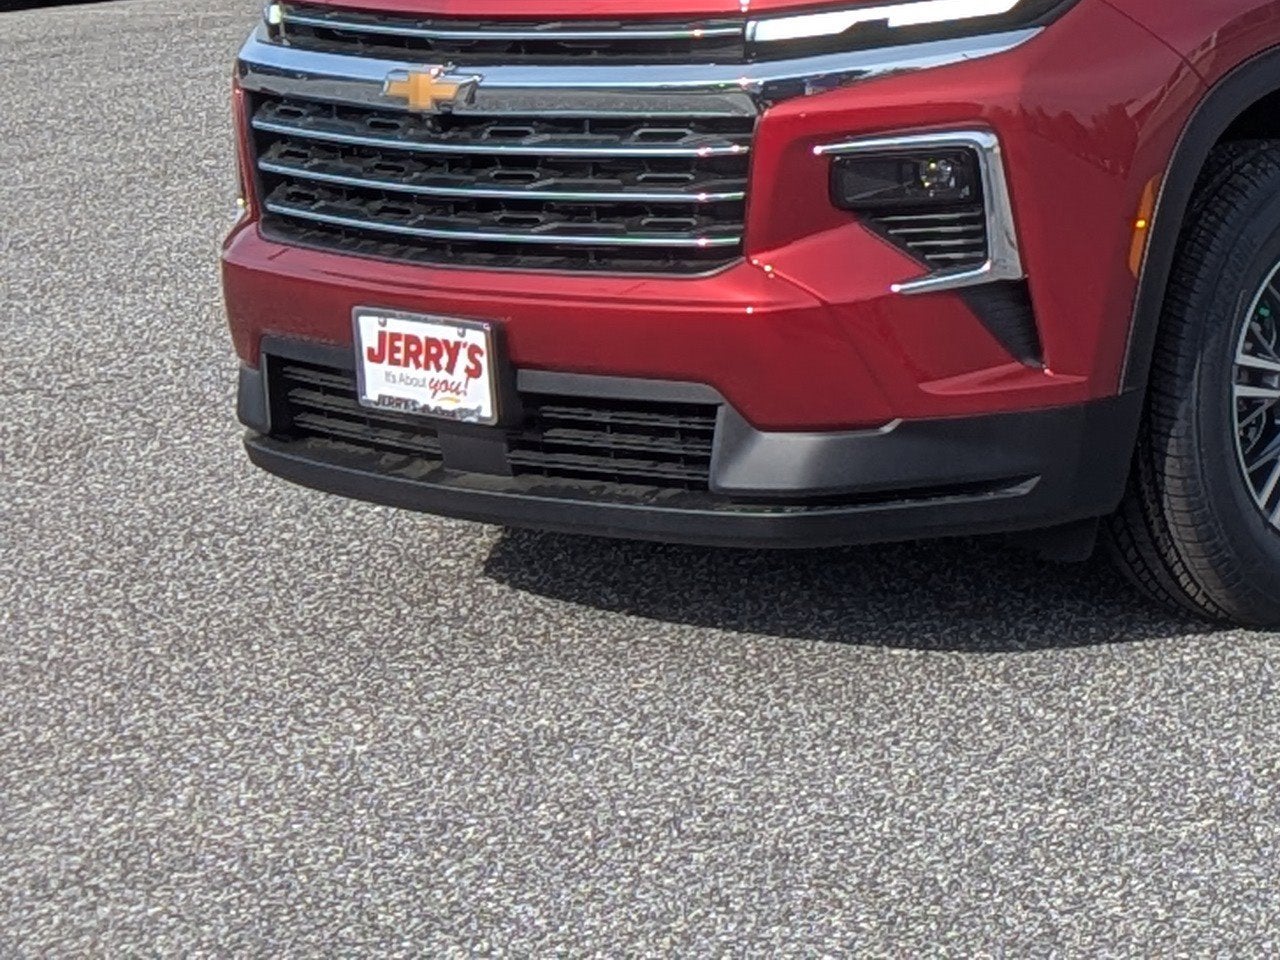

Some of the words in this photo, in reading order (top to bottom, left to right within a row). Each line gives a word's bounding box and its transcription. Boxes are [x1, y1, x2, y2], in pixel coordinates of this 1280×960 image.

[366, 330, 484, 379] JERRY'S
[384, 370, 397, 384] It's
[399, 372, 427, 388] About
[428, 375, 468, 400] you!
